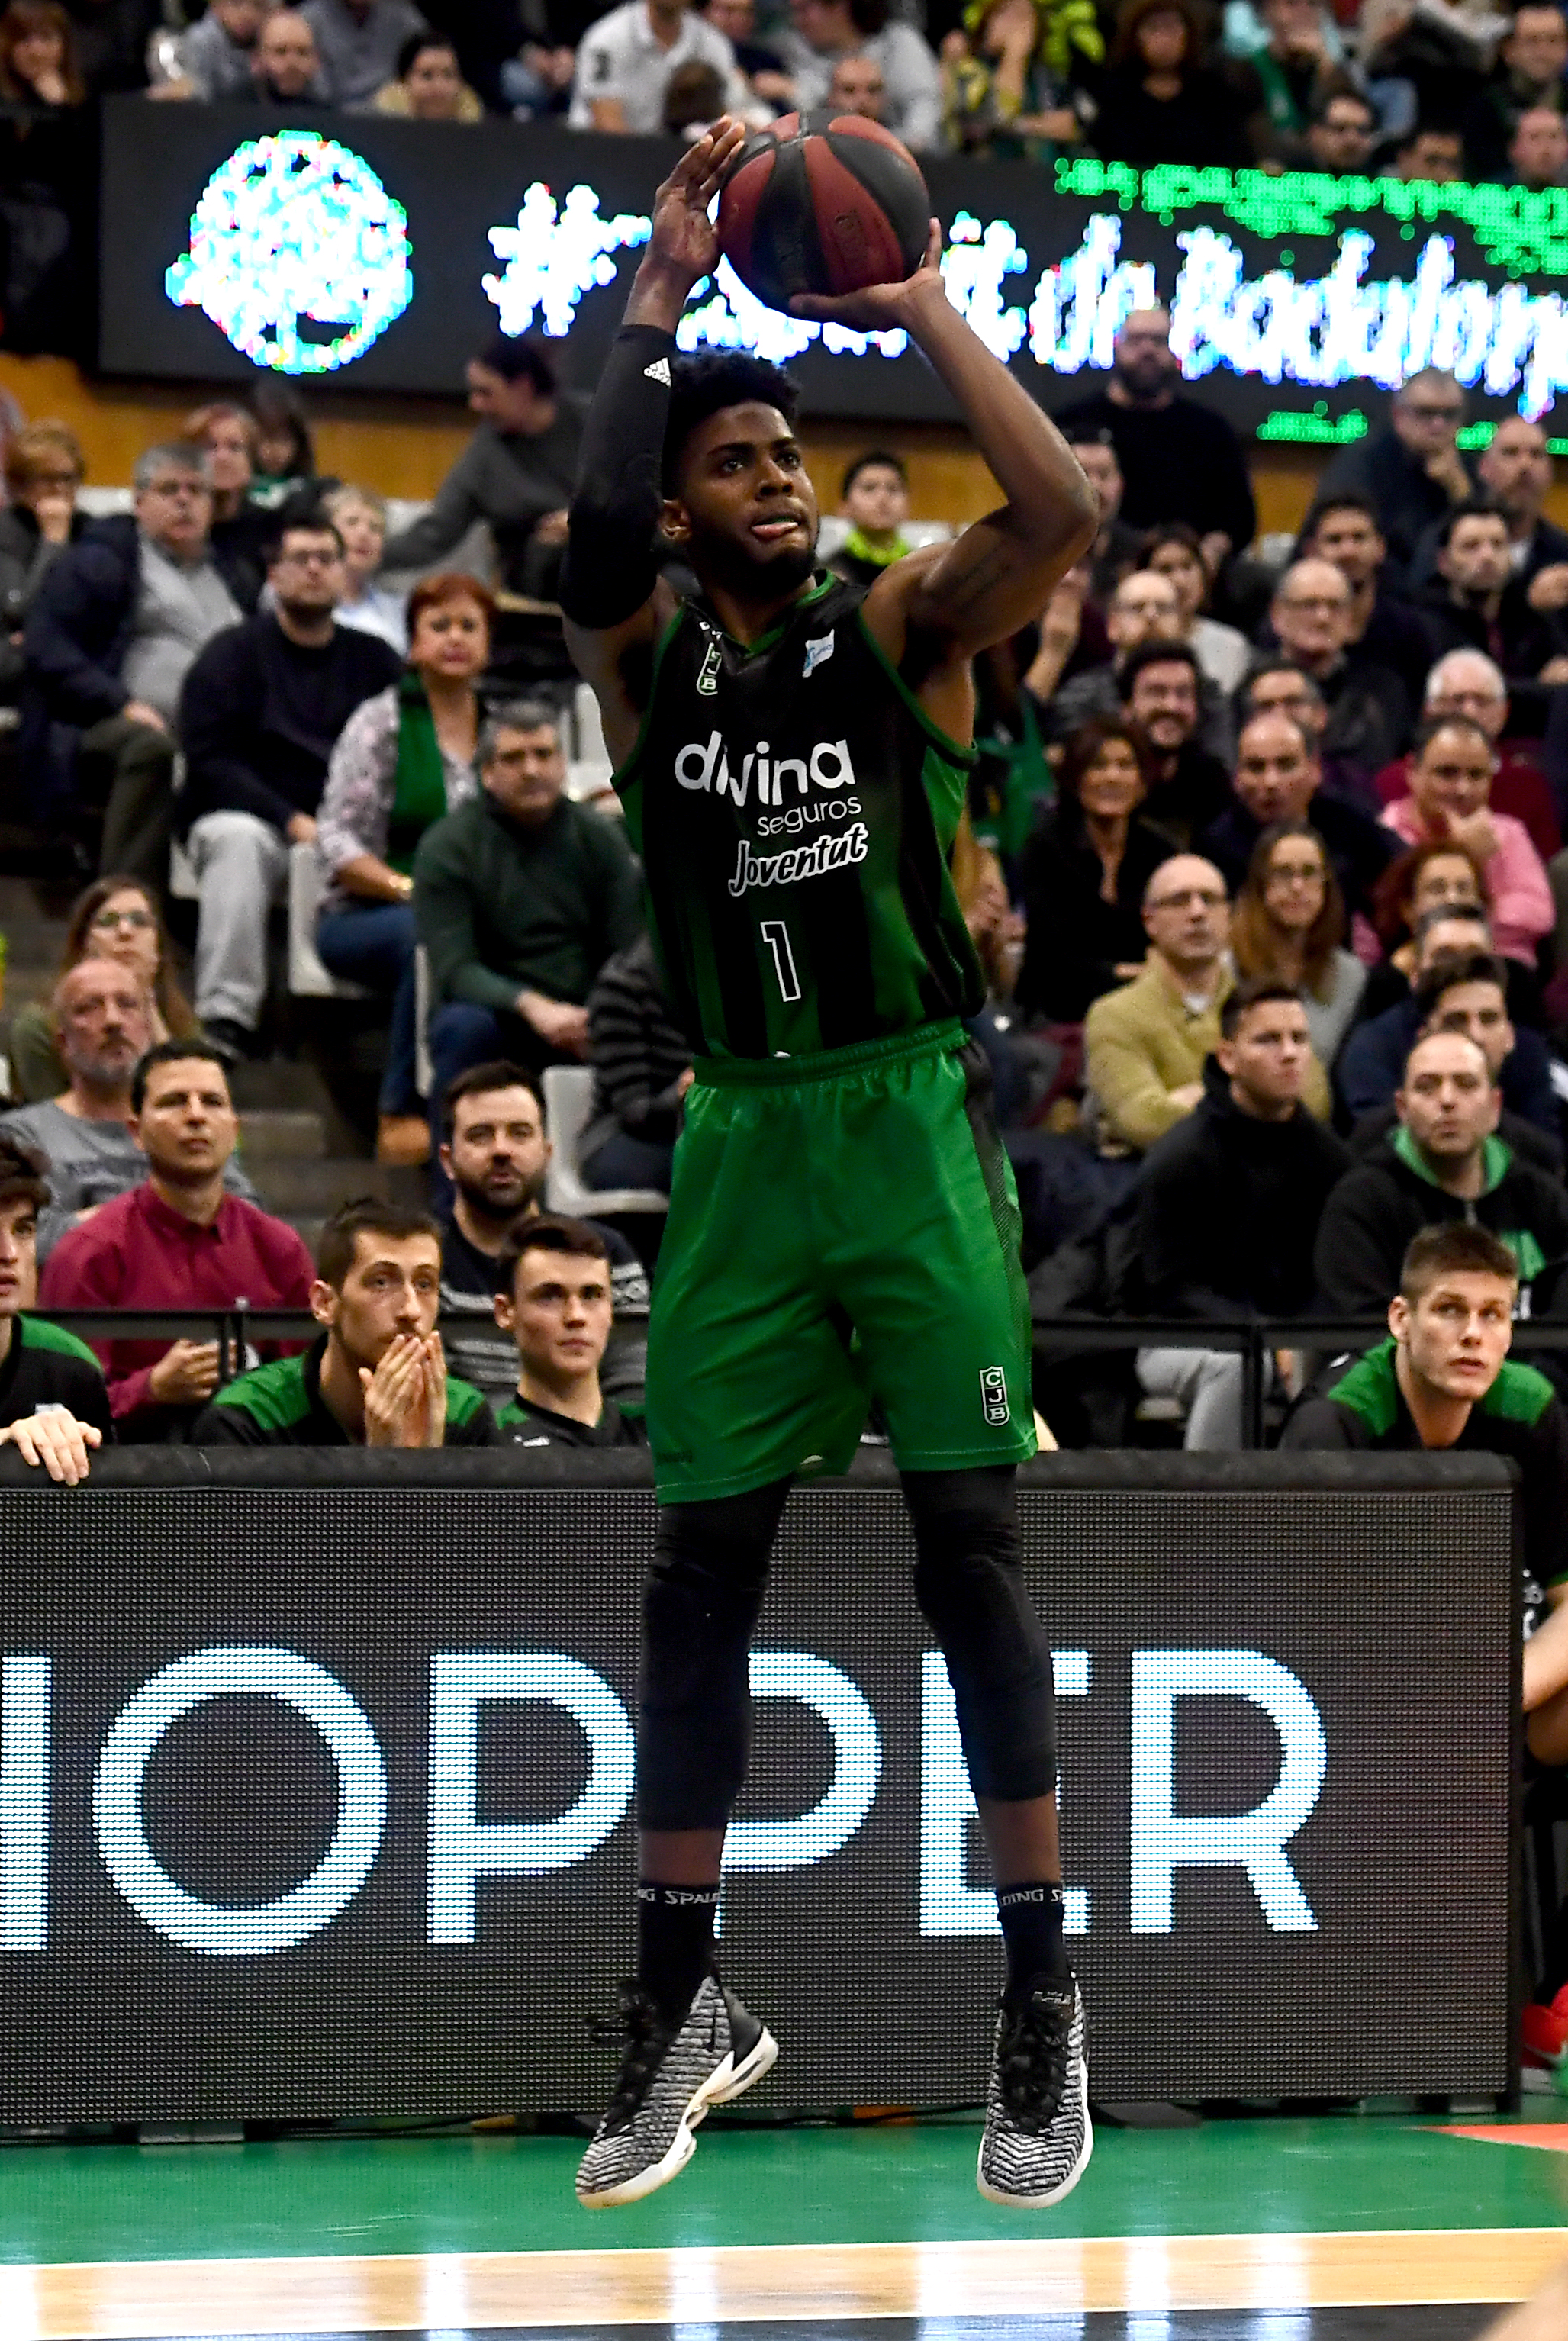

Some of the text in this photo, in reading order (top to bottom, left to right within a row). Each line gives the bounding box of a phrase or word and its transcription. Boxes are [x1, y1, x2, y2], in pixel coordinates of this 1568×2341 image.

[675, 730, 855, 807] divina
[757, 797, 862, 836] seguros
[728, 822, 869, 897] Joventut
[761, 920, 801, 1002] 1
[986, 1371, 1006, 1420] CJB
[0, 1644, 1328, 1956] OPPER
